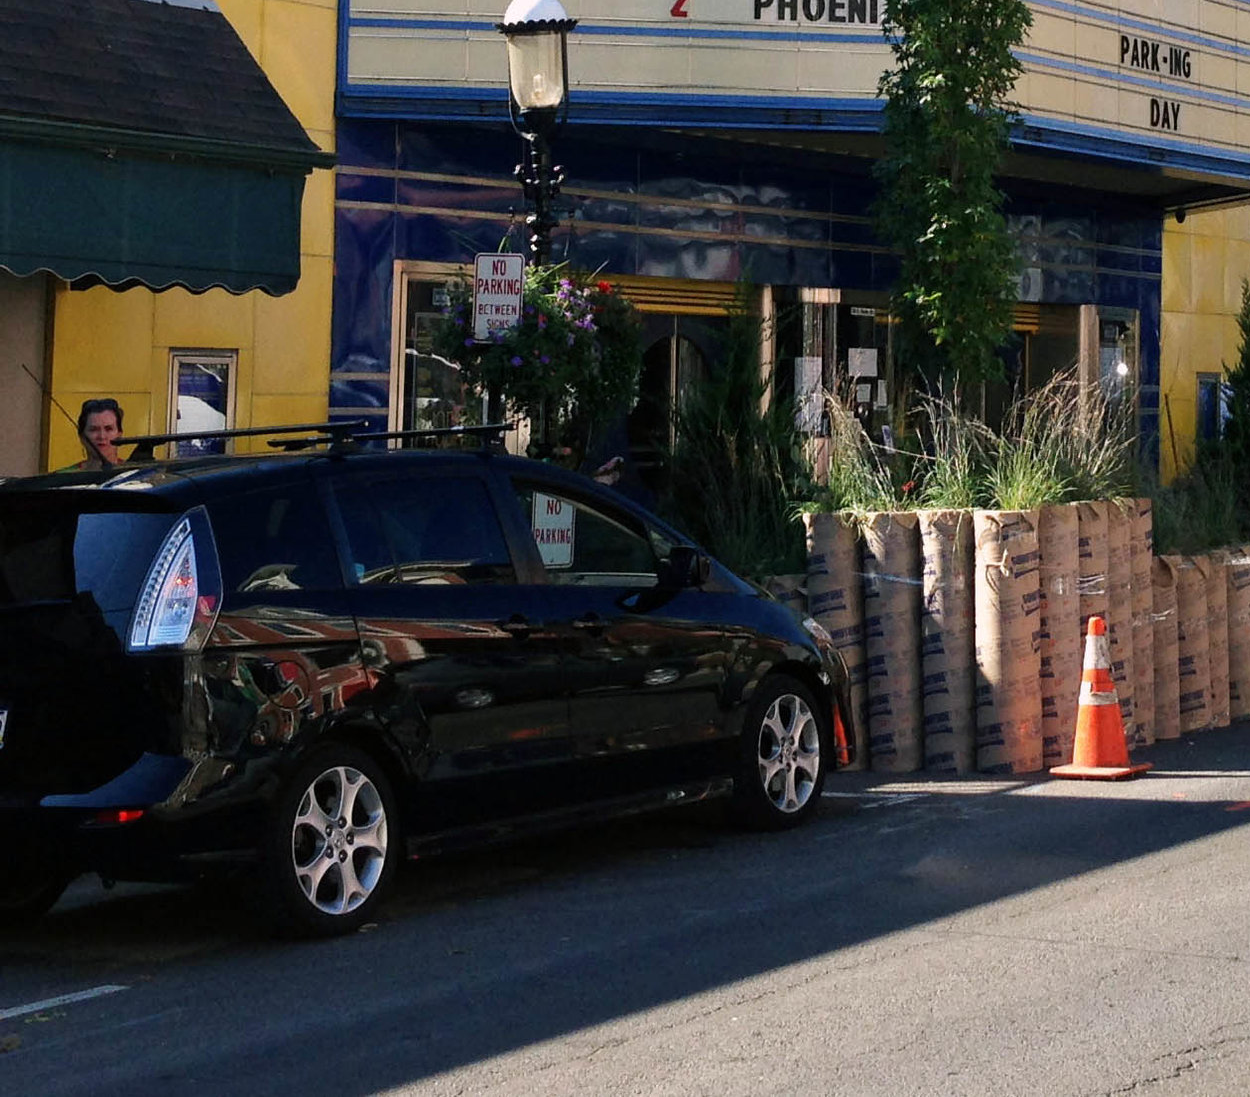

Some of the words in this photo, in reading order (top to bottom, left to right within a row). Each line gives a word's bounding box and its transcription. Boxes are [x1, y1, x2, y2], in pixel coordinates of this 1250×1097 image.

[1120, 35, 1191, 79] PARK-ING
[1150, 97, 1181, 131] DAY
[492, 259, 507, 276] NO
[477, 278, 520, 295] PARKING
[478, 303, 517, 316] BETWEEN
[486, 318, 510, 330] SIGNS
[546, 499, 562, 516] NO
[535, 528, 571, 544] PARKING
